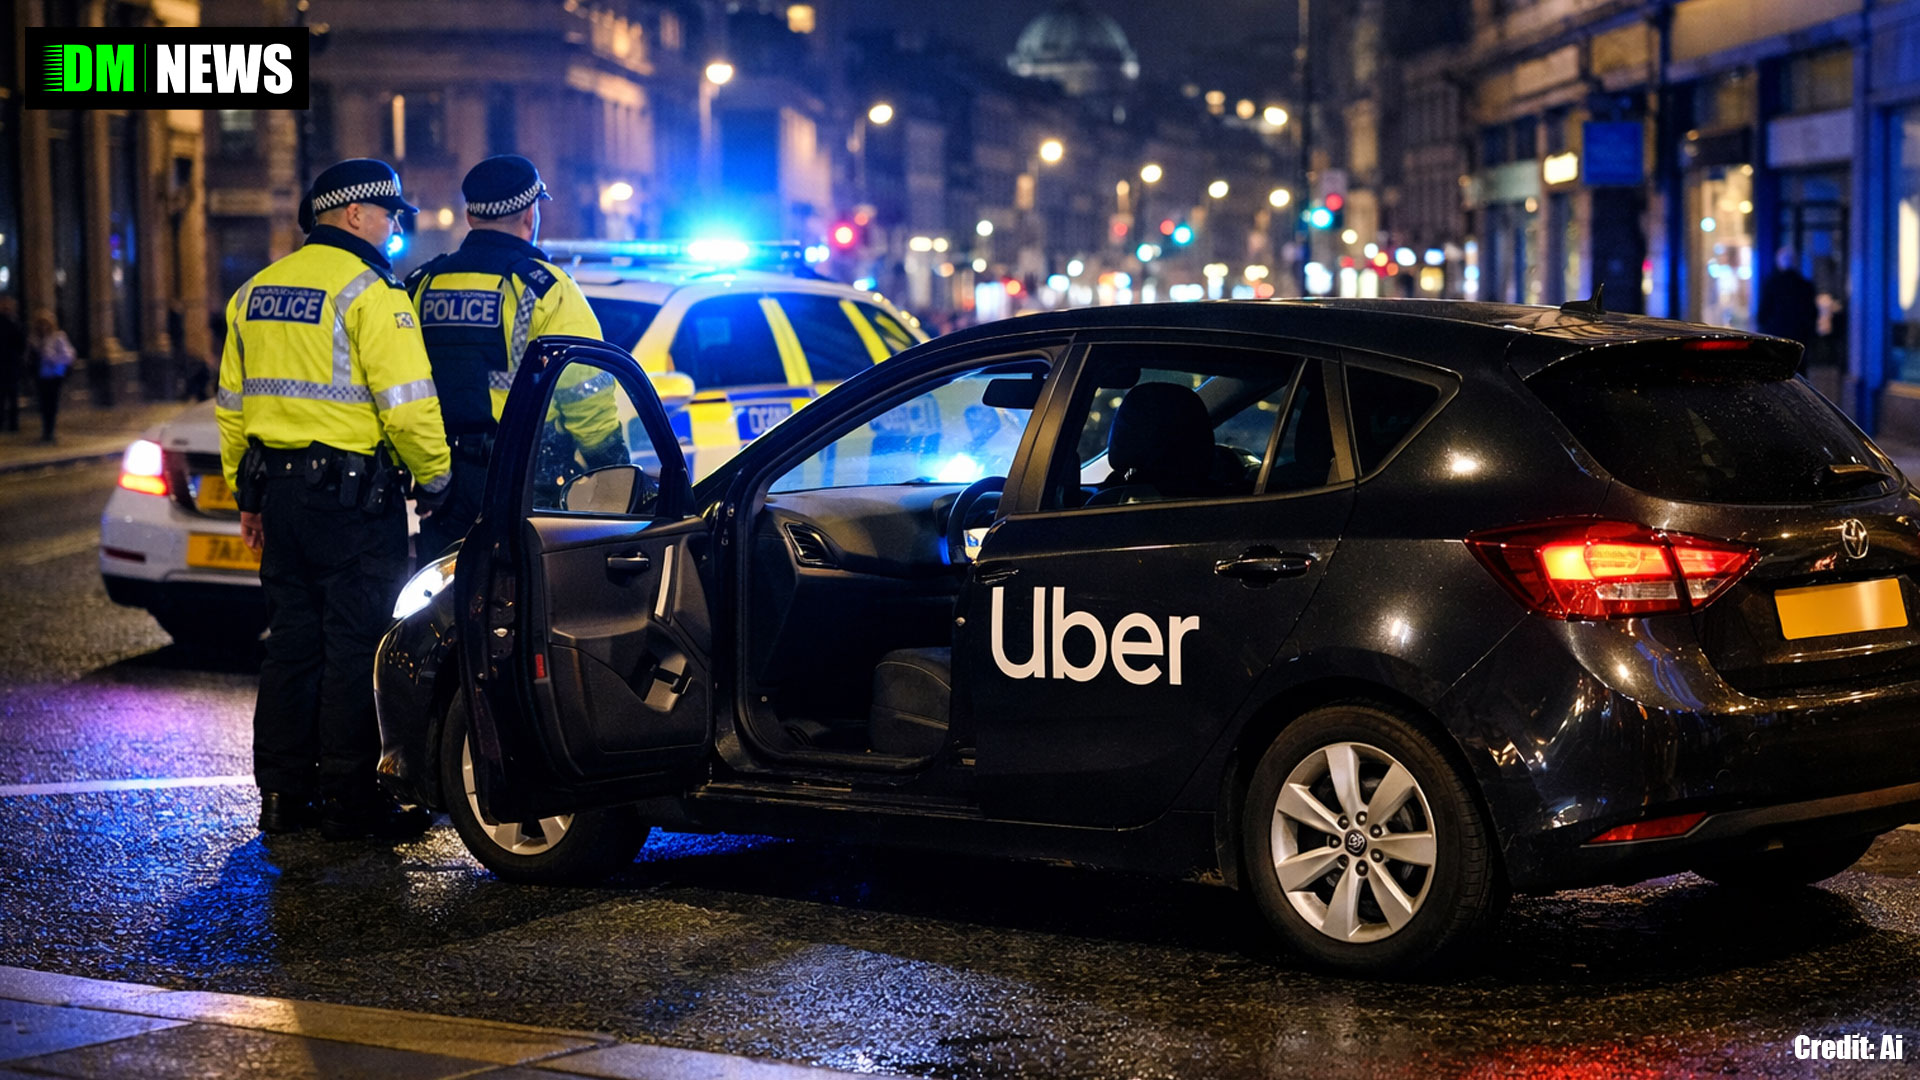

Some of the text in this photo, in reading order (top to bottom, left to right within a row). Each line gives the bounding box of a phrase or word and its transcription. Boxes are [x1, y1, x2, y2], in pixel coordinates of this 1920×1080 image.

[249, 295, 321, 320] POLICE
[423, 298, 497, 322] POLICE
[990, 586, 1200, 686] Uber
